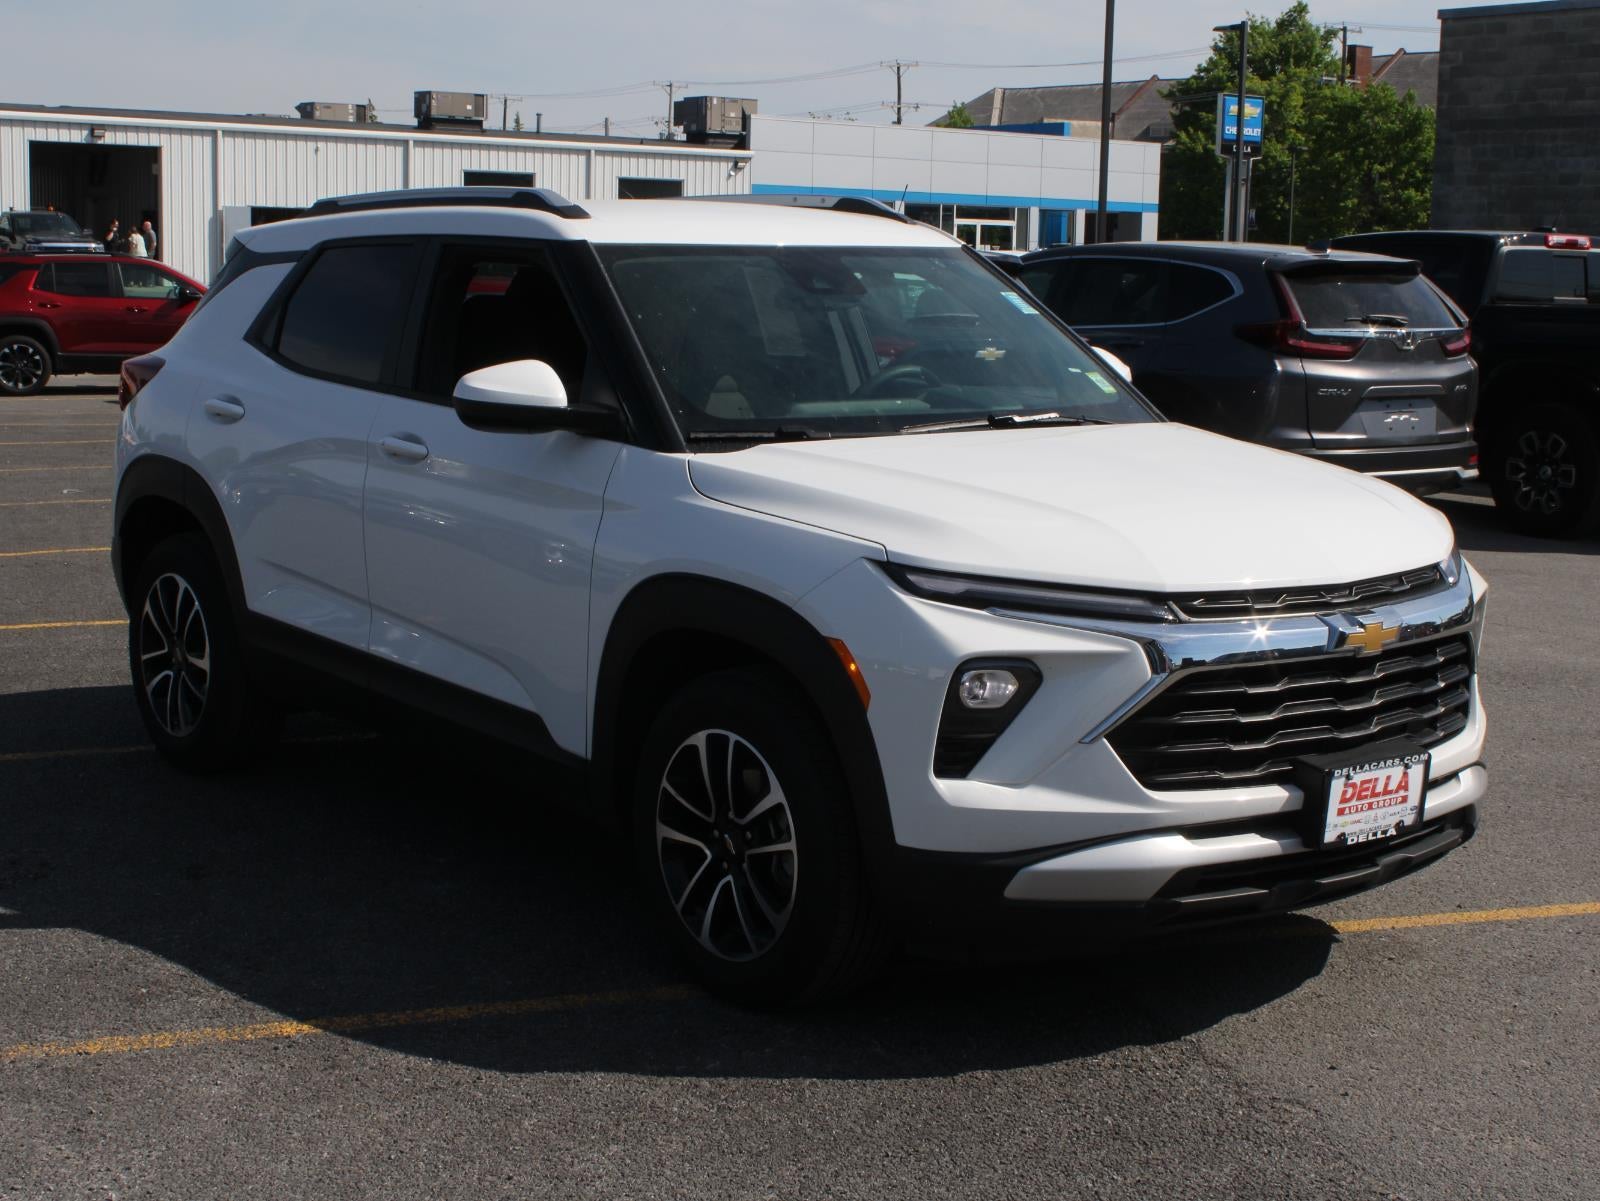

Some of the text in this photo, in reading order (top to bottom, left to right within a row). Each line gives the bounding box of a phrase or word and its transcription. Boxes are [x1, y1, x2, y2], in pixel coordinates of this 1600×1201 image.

[1334, 753, 1428, 777] DELLACARS.COM
[1338, 771, 1409, 805] DELLA
[1343, 797, 1403, 815] AUTO GROUP
[1346, 828, 1397, 846] DELLA
